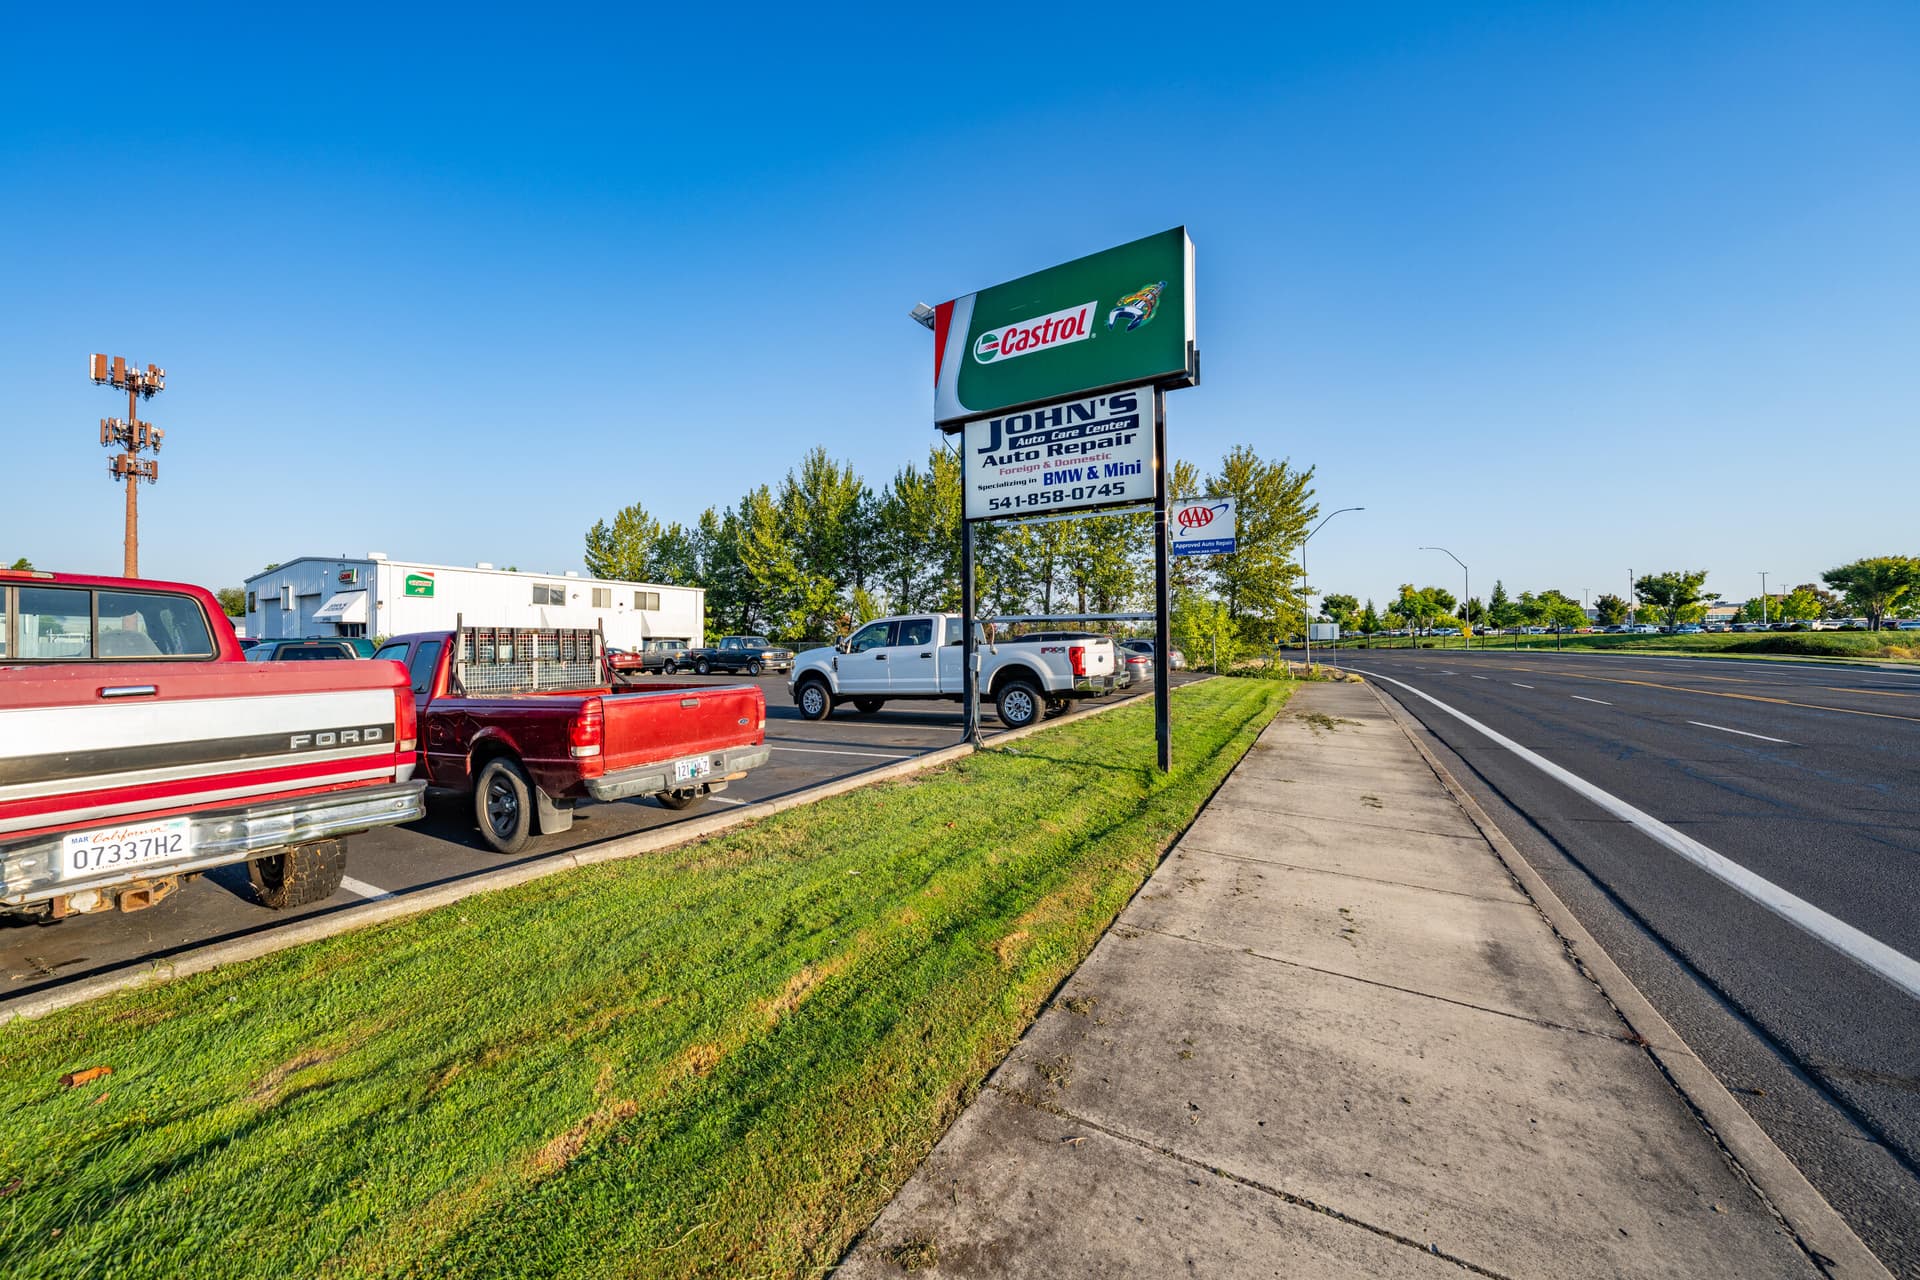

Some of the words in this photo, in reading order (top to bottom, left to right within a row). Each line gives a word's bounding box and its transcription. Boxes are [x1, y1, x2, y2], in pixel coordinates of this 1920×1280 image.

[1000, 307, 1087, 356] Castrol
[977, 391, 1137, 455] JOHN'S
[1015, 435, 1046, 447] Auto
[1051, 429, 1080, 441] Care
[1085, 419, 1131, 435] Center
[982, 450, 1040, 468] Auto
[1047, 432, 1137, 457] Repair
[999, 463, 1040, 476] Foreign
[1042, 460, 1051, 469] &
[1054, 452, 1112, 467] Domestic
[977, 480, 1027, 491] Specializing
[1028, 477, 1037, 485] in
[1043, 467, 1083, 486] BMW
[1086, 465, 1099, 480] &
[1104, 459, 1142, 478] Mini
[989, 481, 1125, 511] 541-858-0745
[1182, 507, 1210, 527] AAA
[290, 727, 383, 750] FORD
[71, 836, 89, 845] MAR
[92, 826, 164, 844] California
[73, 833, 183, 870] 07337H2
